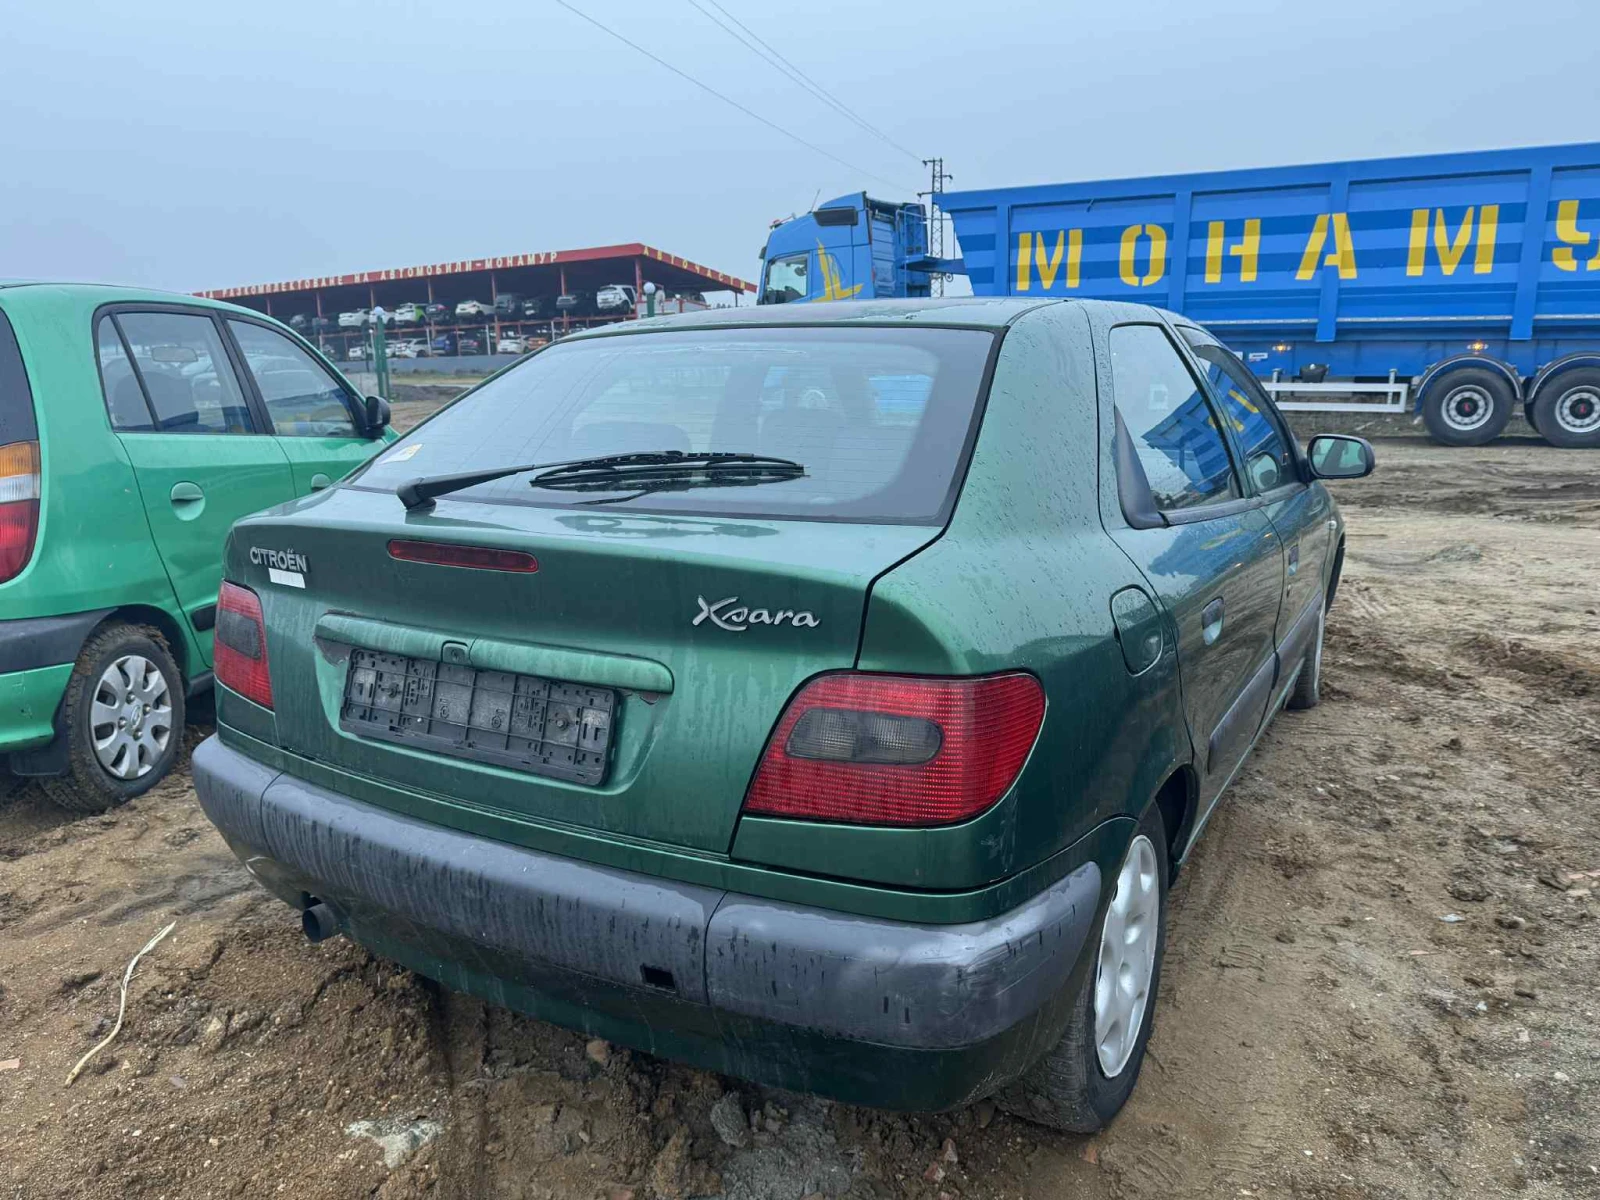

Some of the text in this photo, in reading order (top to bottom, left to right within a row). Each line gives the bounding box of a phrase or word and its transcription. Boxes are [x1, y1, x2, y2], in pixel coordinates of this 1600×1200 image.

[643, 246, 746, 290] АВТОЧАСТИ
[250, 546, 307, 573] CITROËN
[692, 595, 820, 631] Xsara
